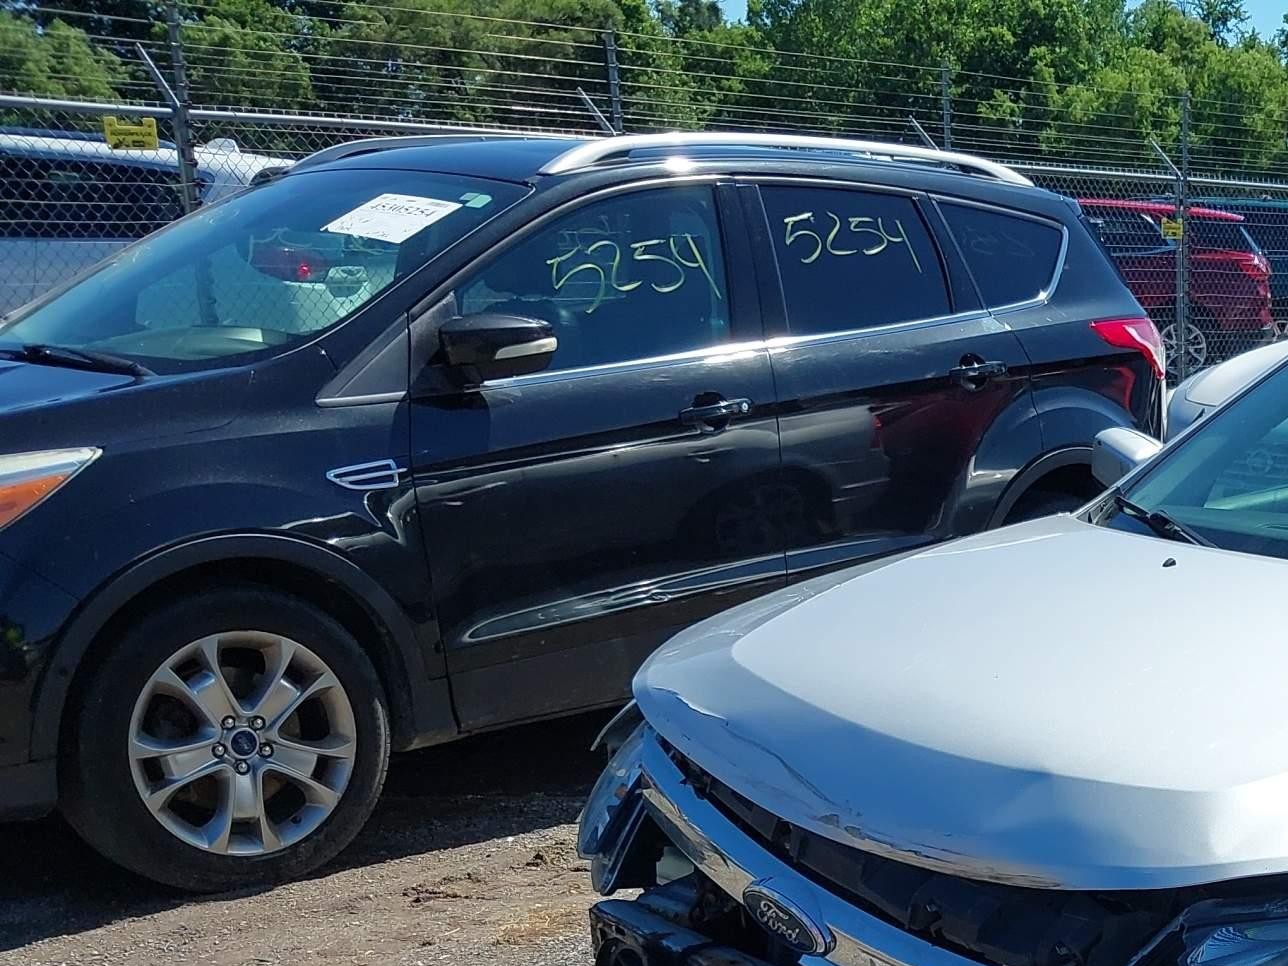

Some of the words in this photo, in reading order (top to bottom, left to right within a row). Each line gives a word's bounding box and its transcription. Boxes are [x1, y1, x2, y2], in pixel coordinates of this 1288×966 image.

[784, 211, 922, 273] 5254
[546, 233, 722, 314] 5254
[757, 901, 799, 943] Ford
